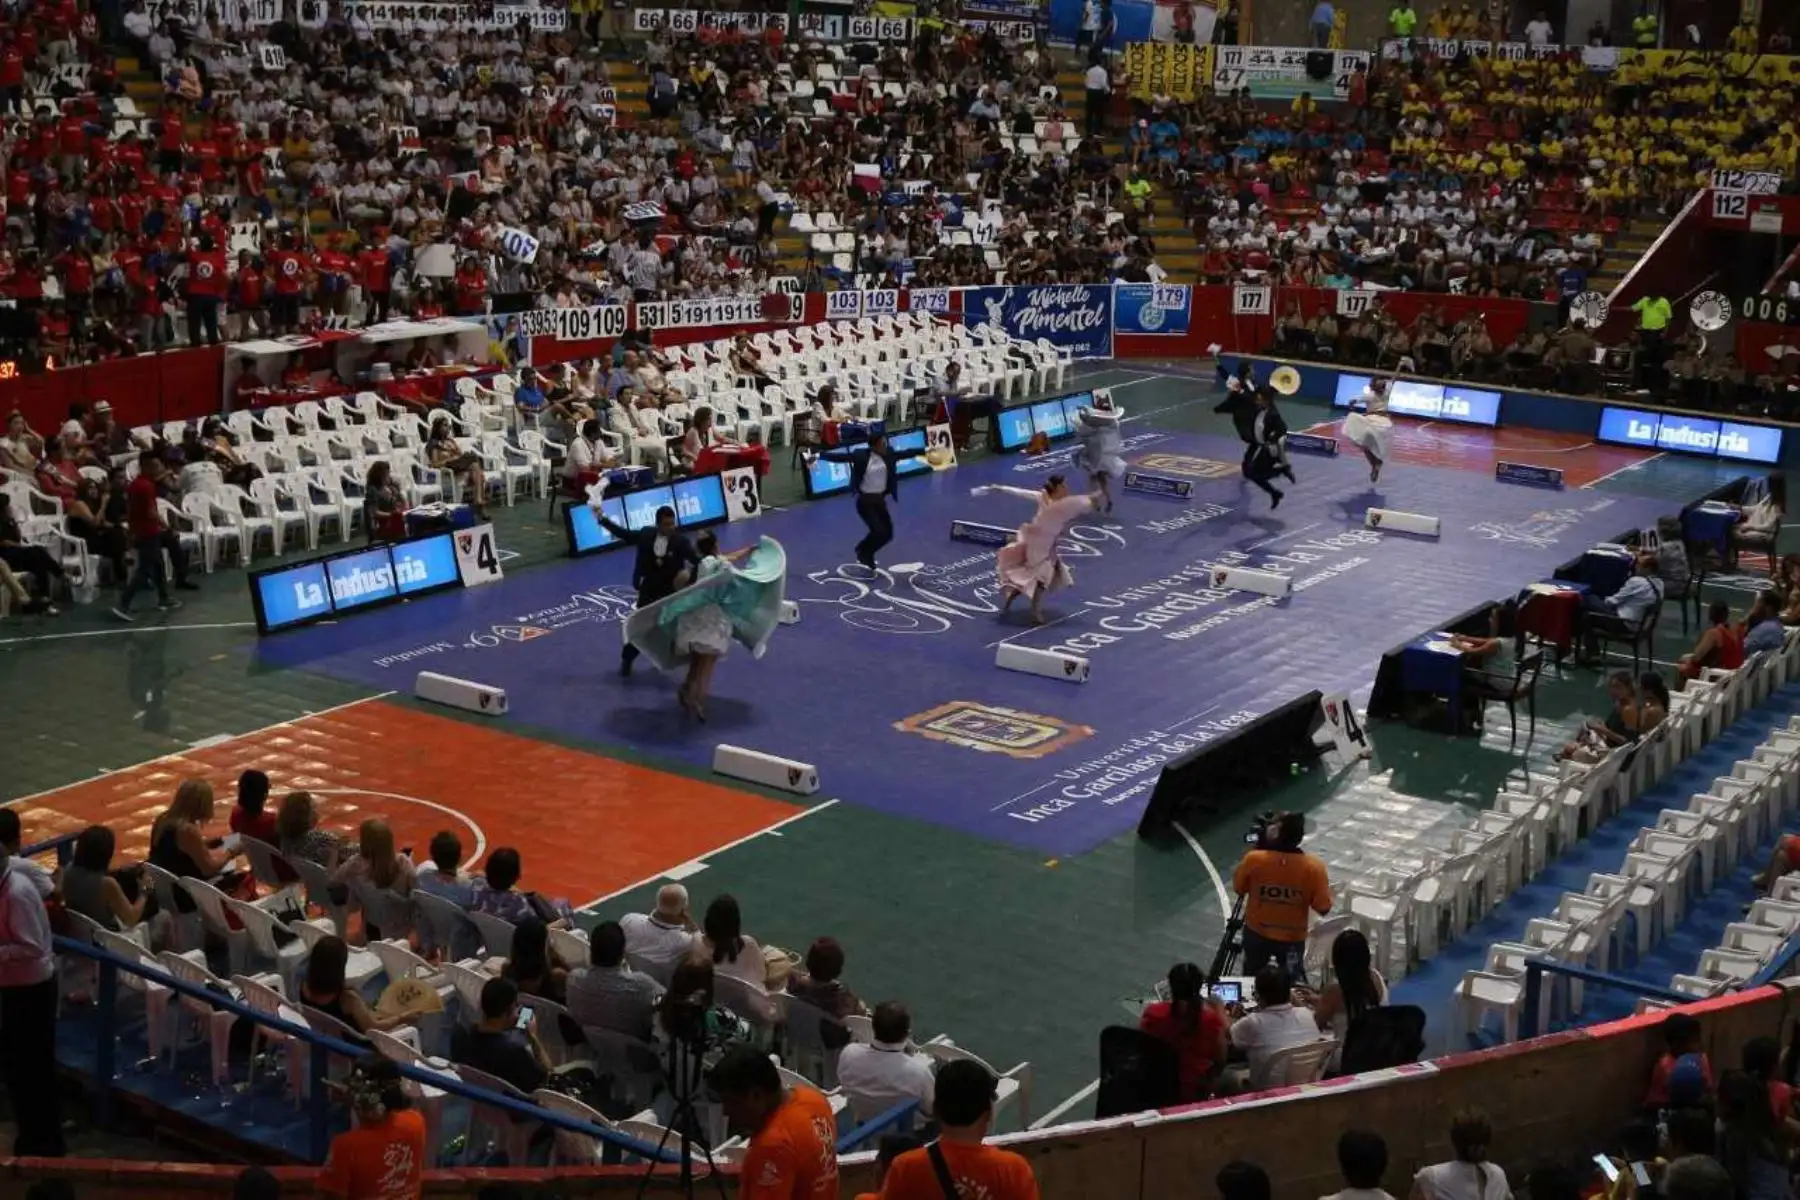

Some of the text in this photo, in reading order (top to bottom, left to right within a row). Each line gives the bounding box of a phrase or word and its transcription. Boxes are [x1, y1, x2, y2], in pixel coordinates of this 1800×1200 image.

[638, 13, 660, 29] 66
[673, 14, 693, 30] 66
[853, 20, 873, 36] 66
[883, 22, 903, 37] 66
[1714, 170, 1744, 189] 112
[1716, 195, 1745, 216] 112
[829, 293, 858, 309] 103
[866, 291, 895, 307] 103
[1027, 286, 1091, 309] Michelle
[1241, 293, 1262, 308] 177
[1345, 296, 1367, 311] 177
[559, 309, 590, 338] 109
[594, 307, 625, 336] 109
[639, 304, 665, 326] 531
[1012, 303, 1105, 336] Pimentel
[1627, 419, 1750, 453] La Industria
[738, 475, 758, 514] 3
[476, 533, 498, 575] 4
[293, 555, 428, 609] La Industria
[1342, 699, 1366, 747] 4
[1054, 729, 1171, 781] Universidad
[1007, 797, 1077, 823] Inca
[1062, 750, 1169, 800] Garcilaso
[1158, 732, 1196, 754] de
[1190, 724, 1217, 743] la
